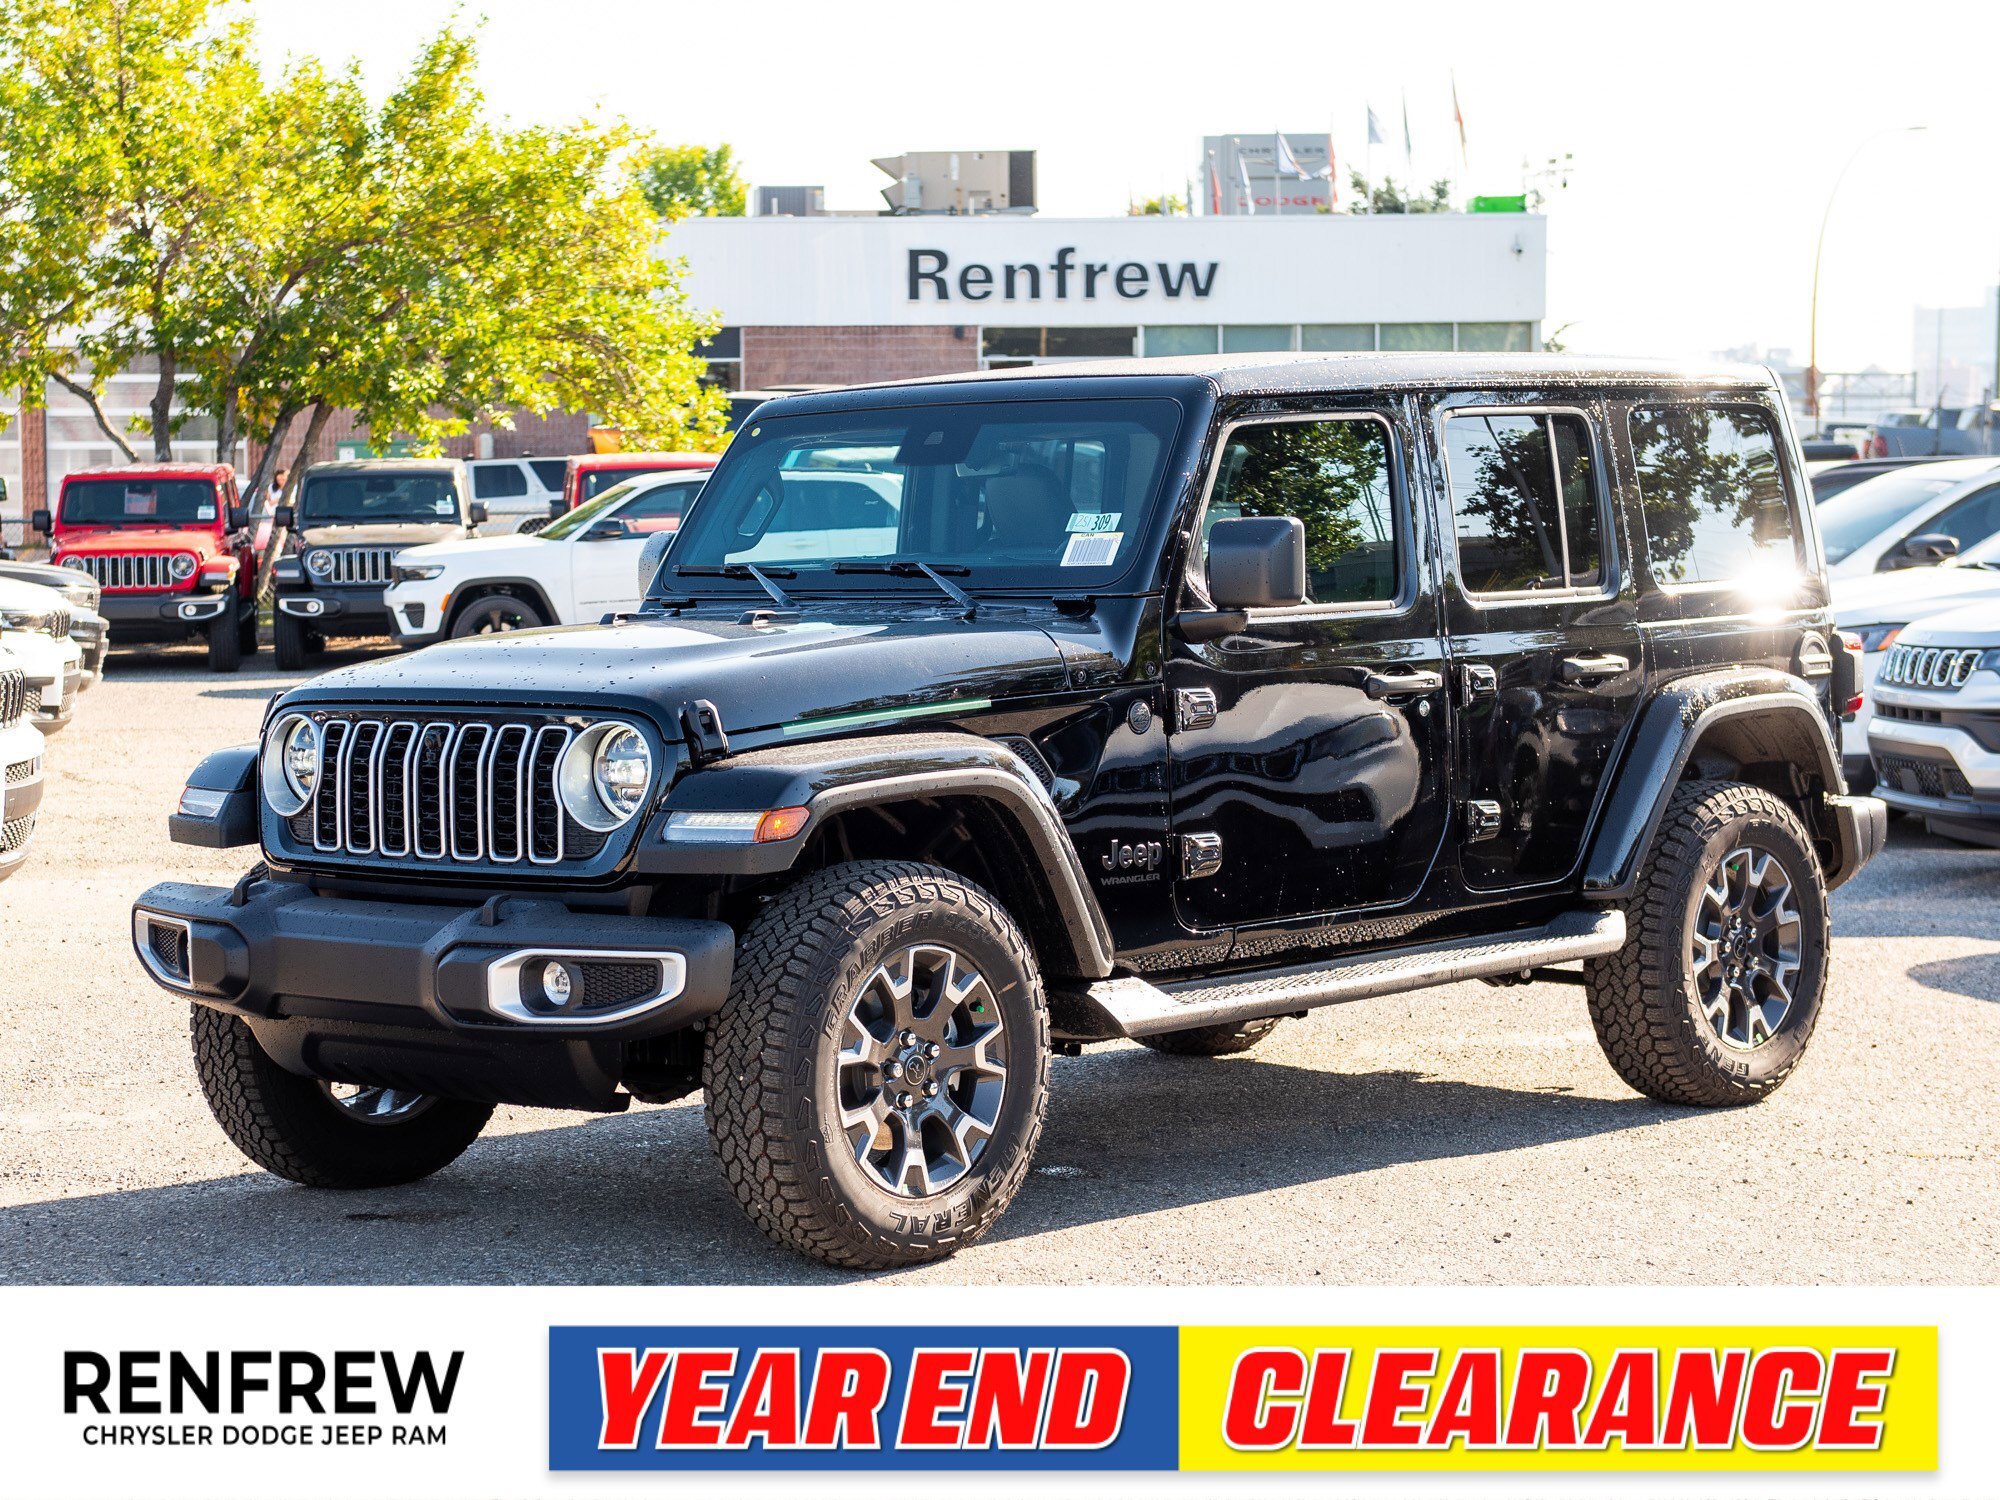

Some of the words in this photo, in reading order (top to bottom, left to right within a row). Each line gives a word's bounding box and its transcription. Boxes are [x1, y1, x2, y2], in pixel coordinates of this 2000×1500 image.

[909, 247, 1219, 300] Renfrew
[1091, 514, 1112, 531] 309
[1102, 839, 1163, 871] Jeep
[1100, 873, 1161, 886] WRANGLER
[822, 910, 934, 1040] GRABBER
[889, 1132, 1022, 1236] GENERAL
